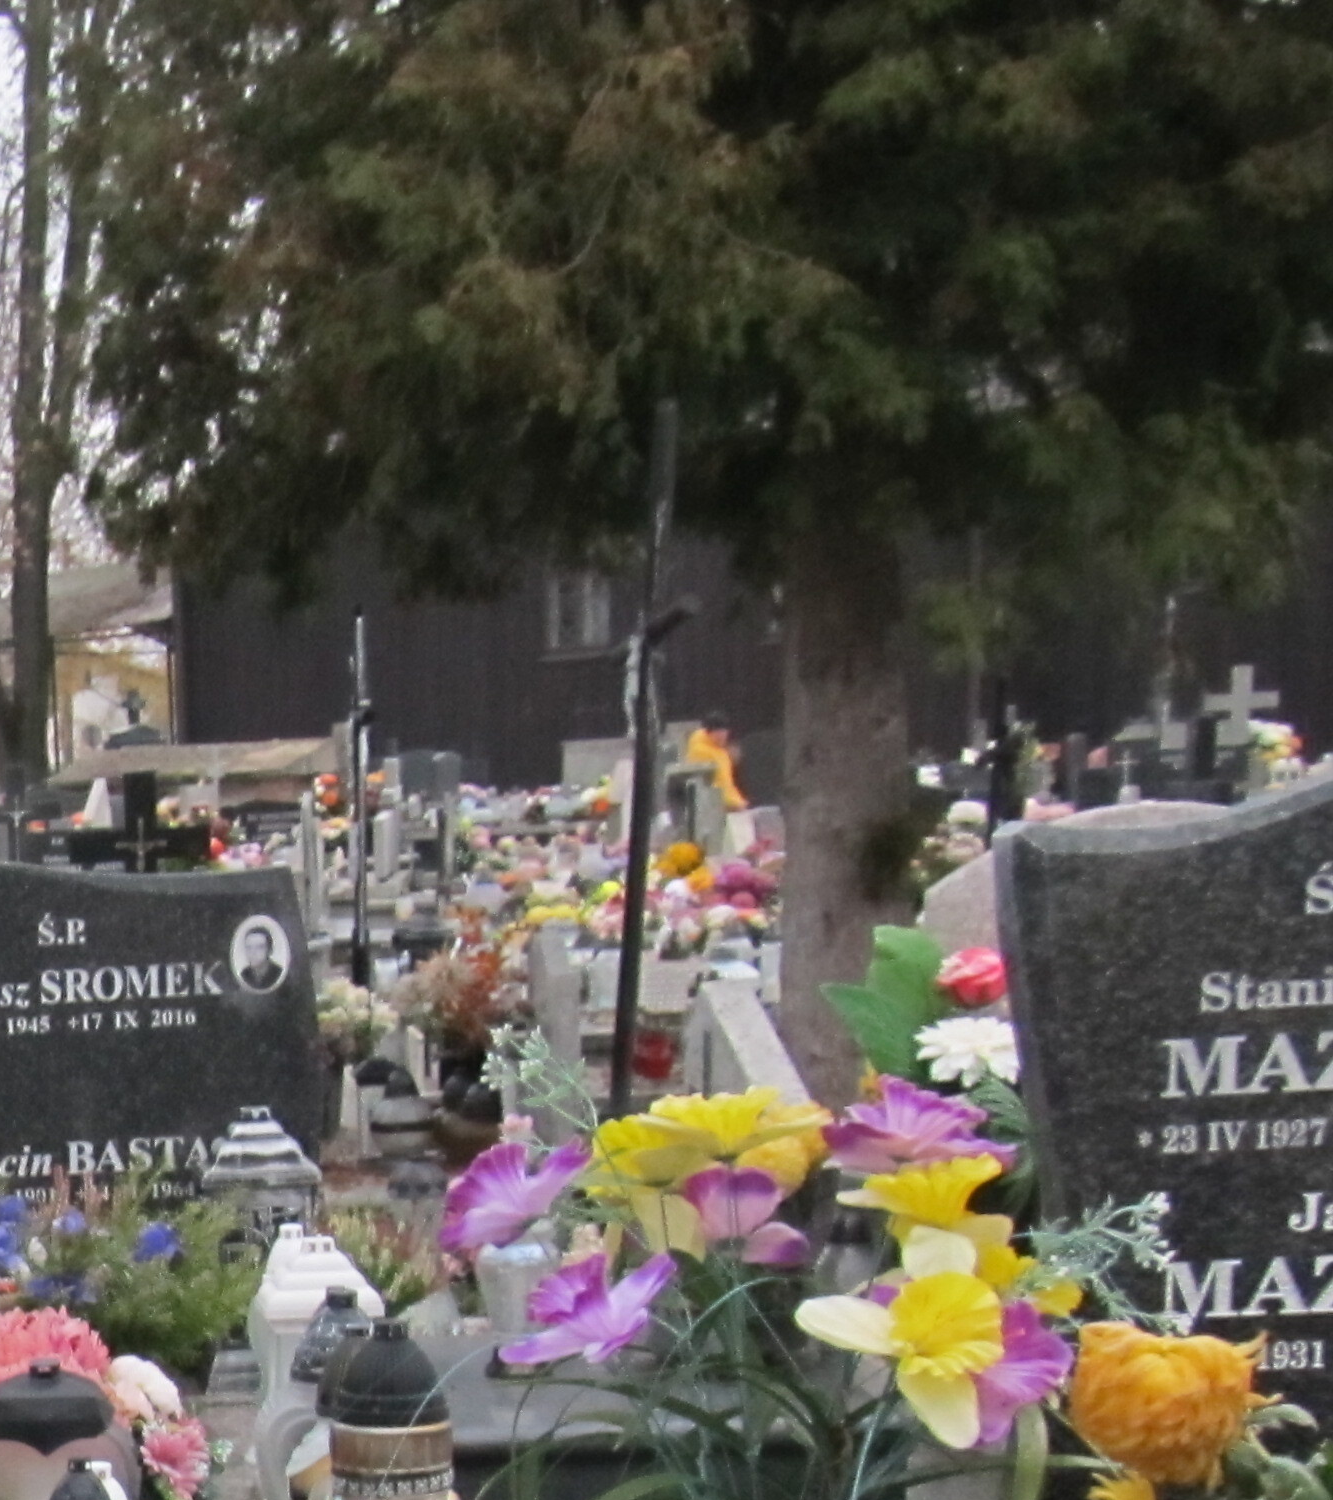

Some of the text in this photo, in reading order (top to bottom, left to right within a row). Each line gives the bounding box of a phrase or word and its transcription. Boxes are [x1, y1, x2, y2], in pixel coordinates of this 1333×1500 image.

[38, 912, 86, 946] Ś.P.
[39, 960, 223, 1005] SROMEK
[6, 1014, 51, 1034] 1945
[114, 1010, 139, 1030] IX
[150, 1008, 197, 1027] 2016
[1161, 1117, 1328, 1153] 23 IV 1927
